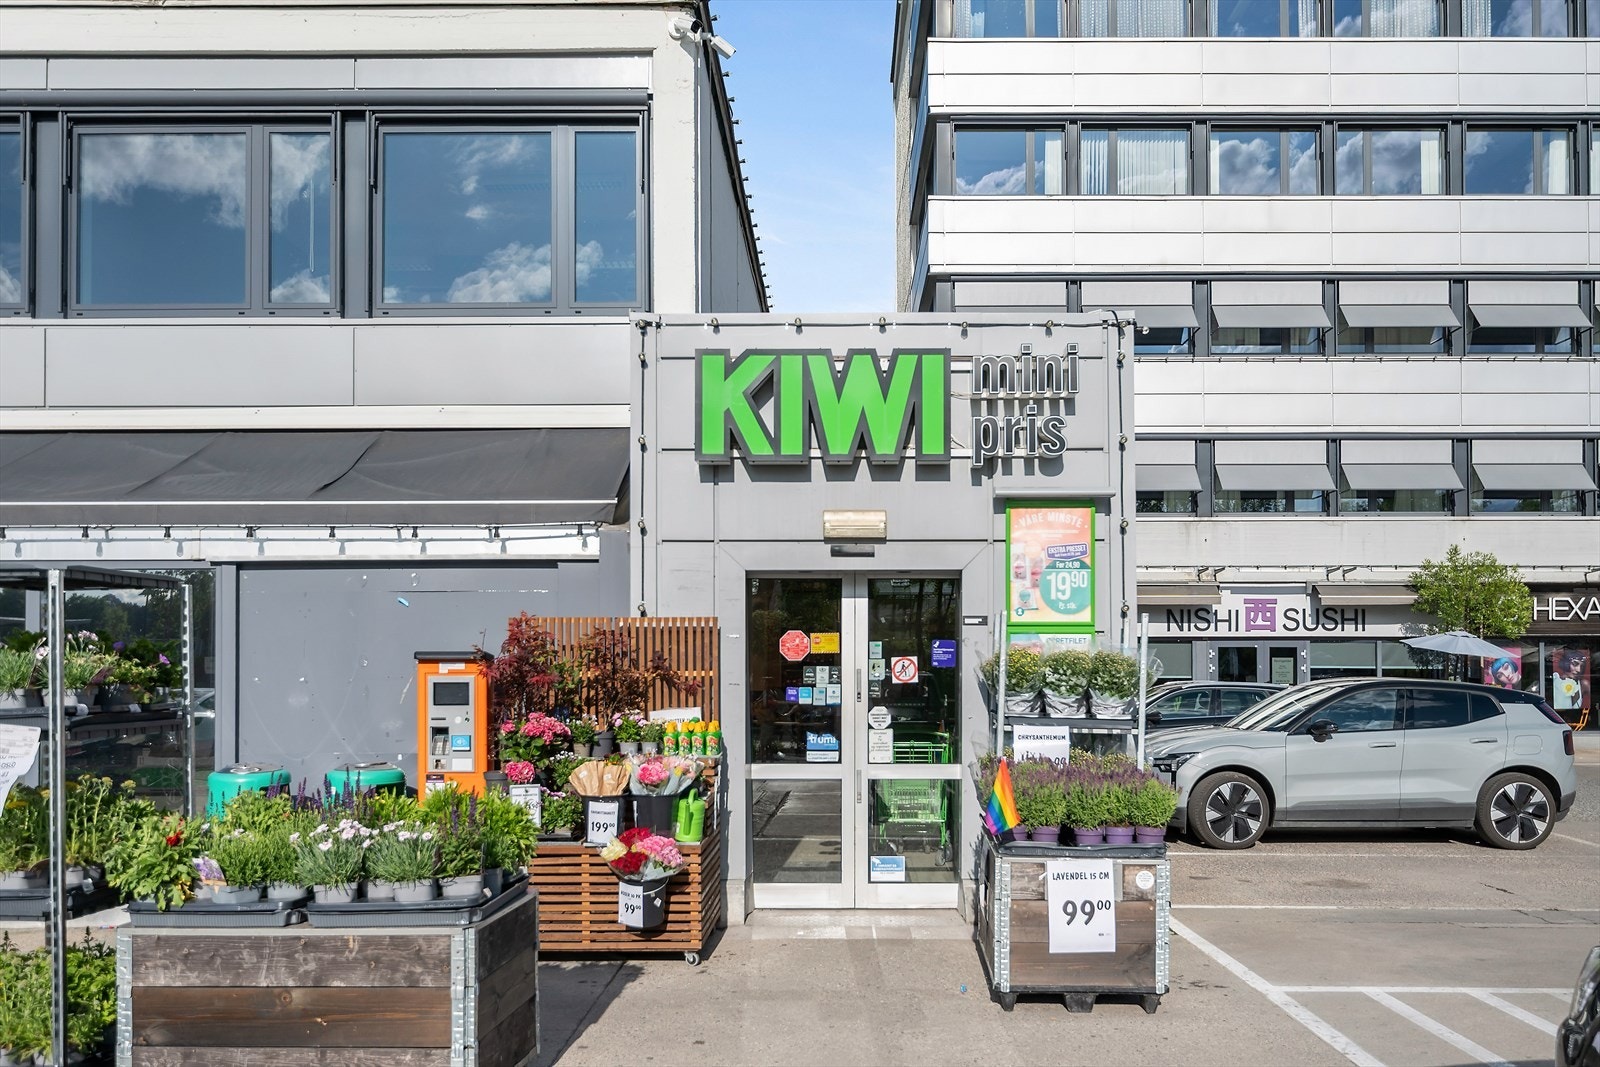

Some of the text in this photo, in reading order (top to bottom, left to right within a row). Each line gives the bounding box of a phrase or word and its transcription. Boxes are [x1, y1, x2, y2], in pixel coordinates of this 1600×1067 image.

[973, 343, 1079, 394] mini
[696, 349, 951, 463] KIWI
[973, 404, 1067, 466] pris
[1047, 511, 1083, 528] MINSTE
[1048, 546, 1066, 554] EKSTRA
[1166, 598, 1366, 632] NISHI 西 SUSHI
[1533, 596, 1600, 621] HEXA
[1052, 871, 1110, 880] LAVENDEL 15 CM
